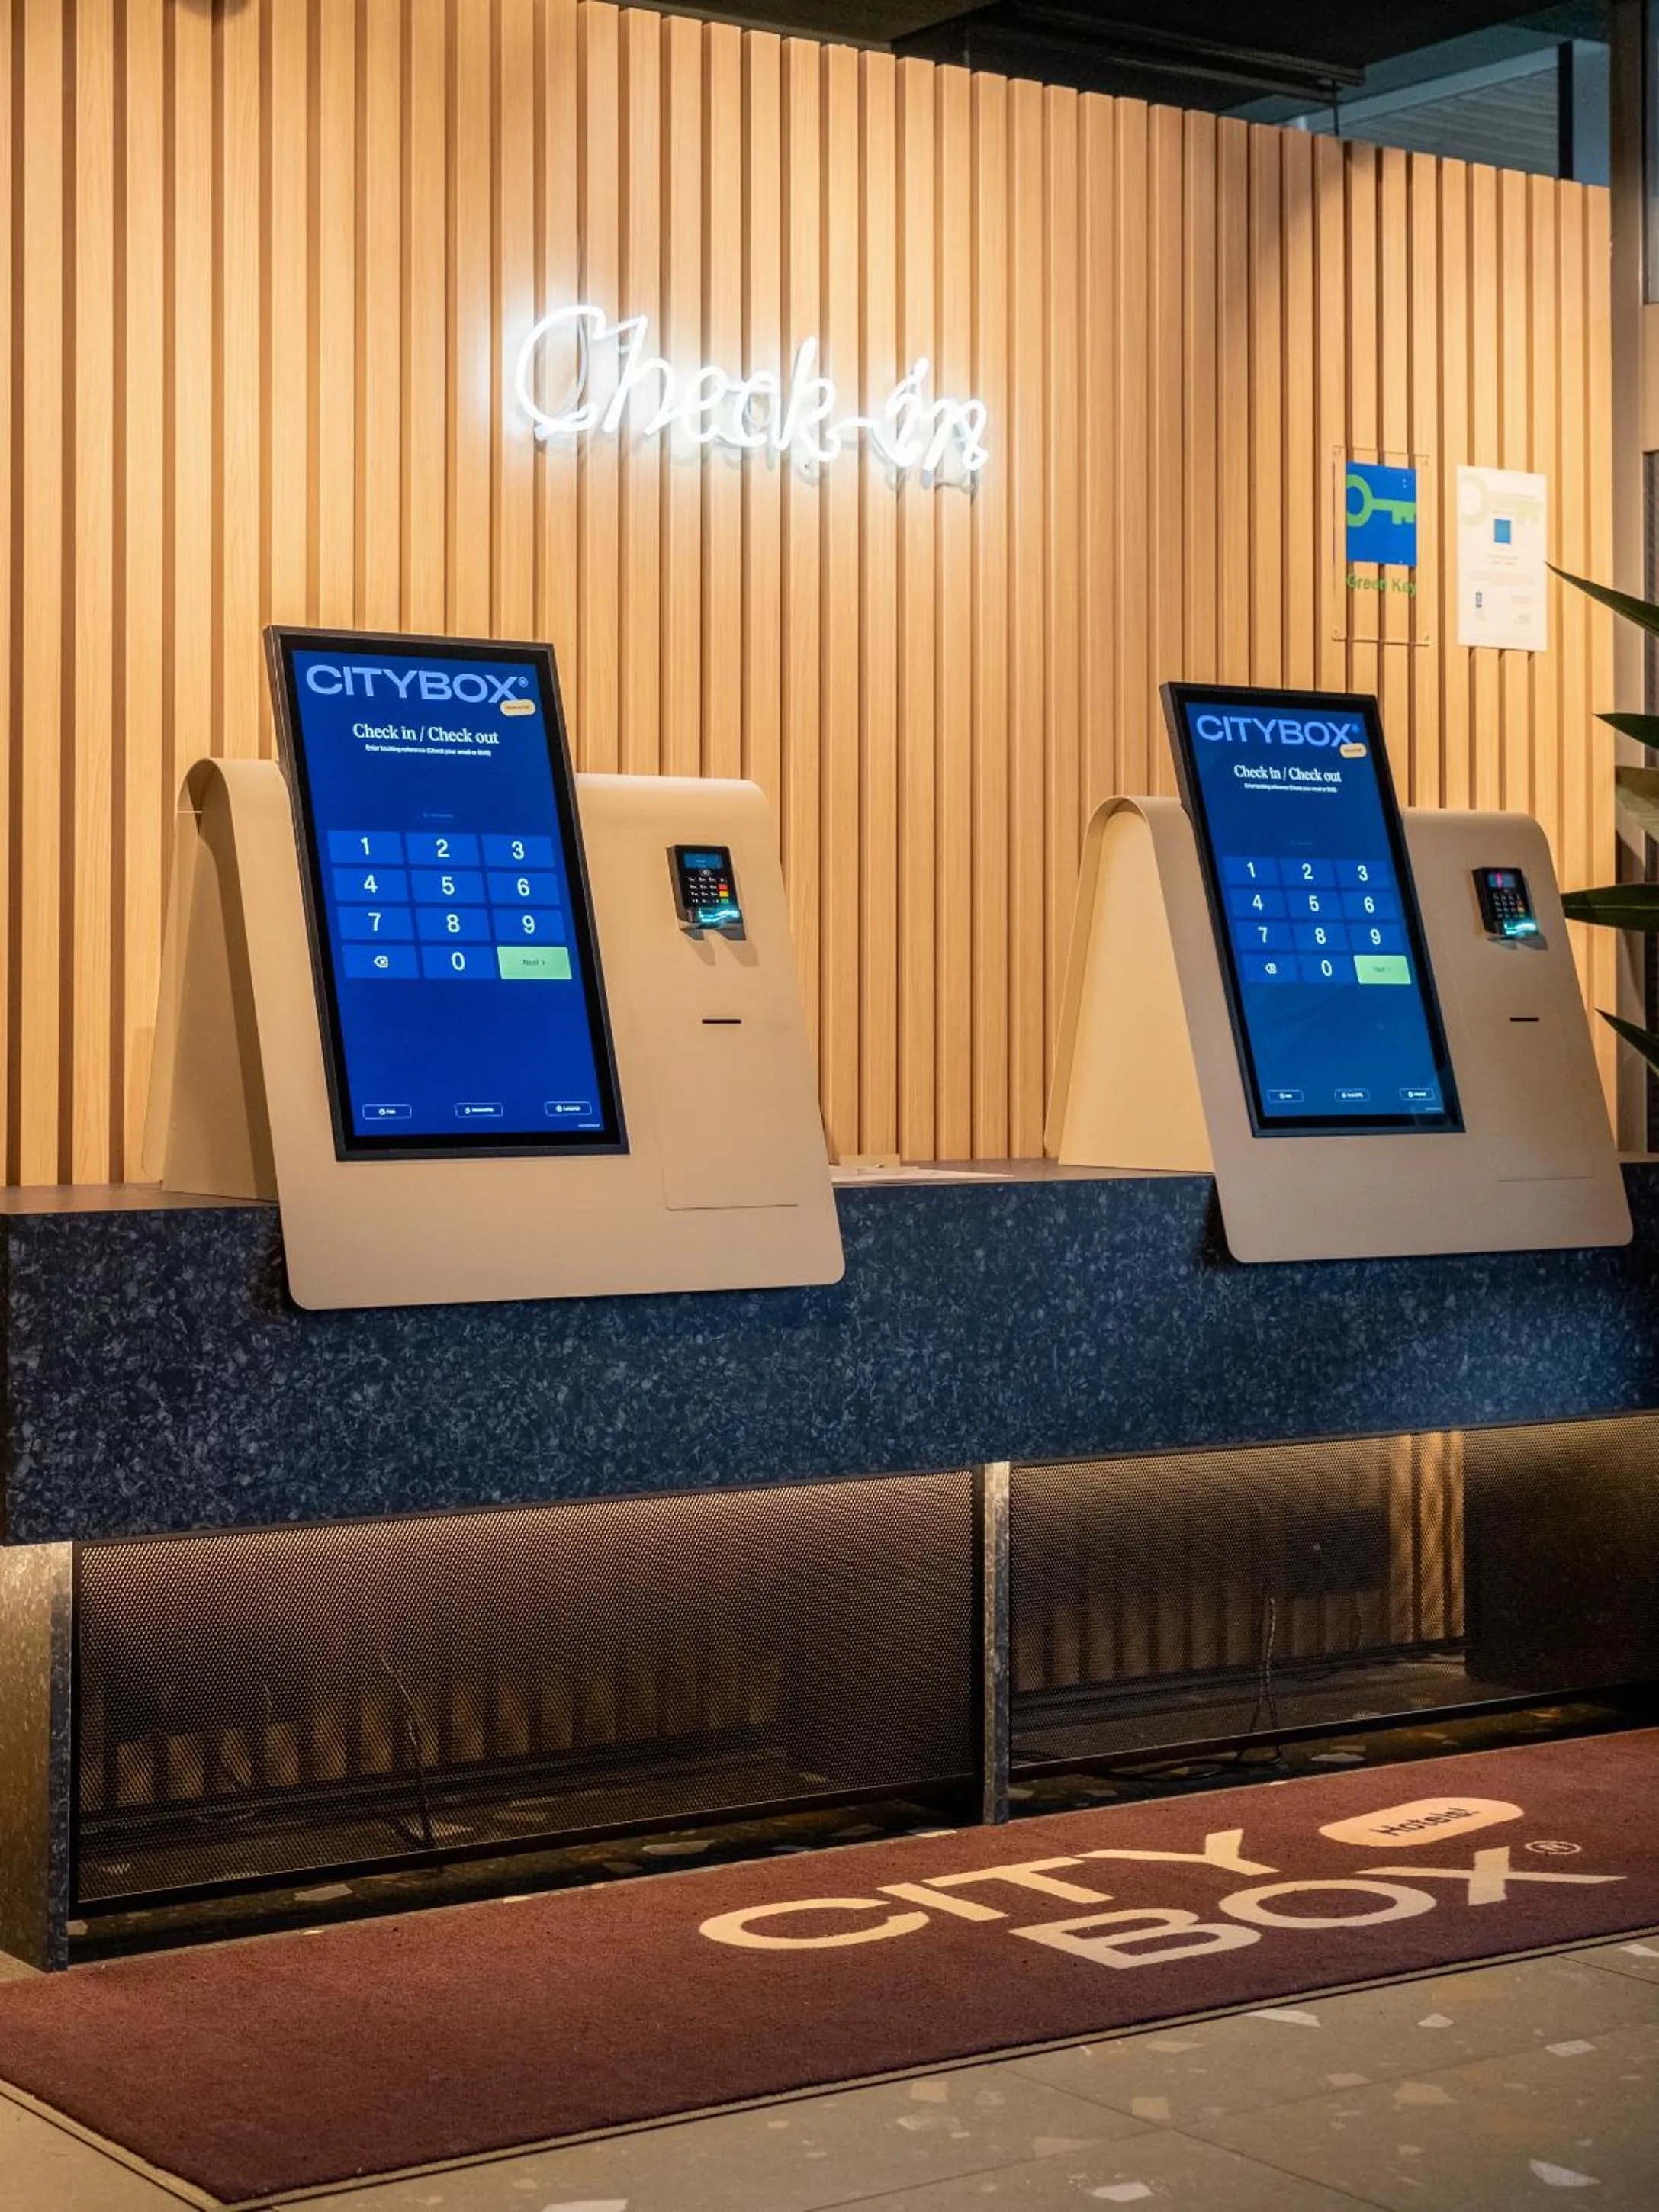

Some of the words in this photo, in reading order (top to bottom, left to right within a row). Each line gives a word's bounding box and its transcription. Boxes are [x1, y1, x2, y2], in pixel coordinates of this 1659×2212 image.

[515, 304, 989, 471] Check-in
[1345, 574, 1387, 590] Green
[1391, 577, 1416, 598] Key
[352, 723, 400, 740] Check
[400, 725, 417, 741] in
[419, 725, 426, 743] /
[427, 726, 474, 743] Check
[475, 731, 500, 744] out
[1233, 765, 1268, 780] Check
[1269, 767, 1282, 780] in
[1288, 767, 1322, 781] Check
[1323, 771, 1342, 783] out
[360, 837, 370, 855] 1
[436, 838, 450, 858] 2
[511, 841, 525, 860] 3
[1246, 861, 1256, 878] 1
[1301, 863, 1313, 879] 2
[1357, 864, 1368, 882] 3
[363, 874, 378, 893] 4
[442, 876, 455, 895] 5
[517, 878, 530, 896] 6
[1252, 894, 1263, 911] 4
[1309, 895, 1320, 912] 5
[1364, 896, 1375, 914] 6
[368, 912, 381, 931] 7
[446, 913, 461, 933] 8
[522, 915, 535, 934] 9
[1258, 926, 1268, 944] 7
[1314, 927, 1326, 945] 8
[1370, 928, 1381, 945] 9
[451, 951, 465, 971] 0
[522, 958, 539, 966] Next
[1320, 960, 1333, 977] 0
[699, 1828, 1280, 1950] CITY
